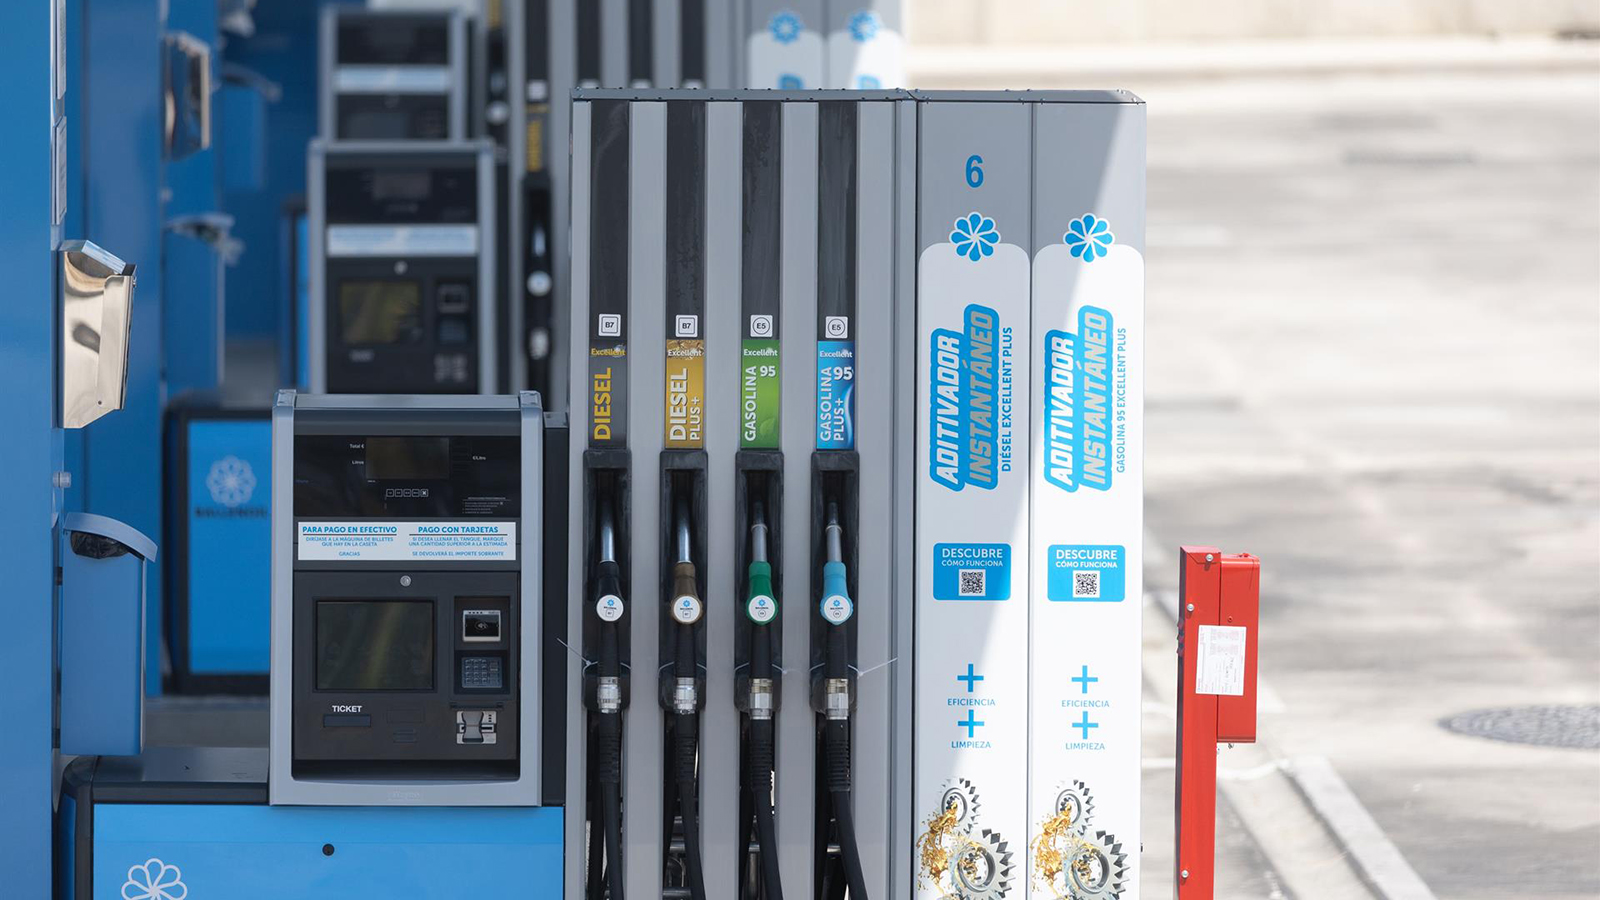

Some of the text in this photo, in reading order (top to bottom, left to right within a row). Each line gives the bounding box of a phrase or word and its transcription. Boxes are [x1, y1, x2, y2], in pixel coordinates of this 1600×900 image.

[966, 154, 984, 188] 6
[591, 348, 626, 356] Excellent
[668, 348, 702, 357] Excellent
[744, 348, 778, 356] Excellent
[760, 366, 776, 377] 95
[820, 350, 852, 358] Excellent
[834, 366, 852, 380] 95
[594, 368, 611, 440] DIESEL
[670, 368, 687, 441] DIESEL
[690, 396, 700, 441] PLUS+
[745, 366, 757, 442] GASOLINA
[820, 366, 832, 442] GASOLINA
[936, 335, 960, 484] ADITIVADOR
[962, 310, 992, 482] INSTANTÁNEO
[999, 327, 1012, 472] DIÉSEL EXCELLENT PLUS
[1050, 336, 1074, 486] ADITIVADOR
[1076, 312, 1106, 484] INSTANTÁNEO
[1116, 328, 1126, 473] GASOLINA 95 EXCELLENT PLUS
[834, 398, 844, 441] PLUS+
[942, 548, 1003, 559] DESCUBRE
[1056, 550, 1117, 560] DESCUBRE
